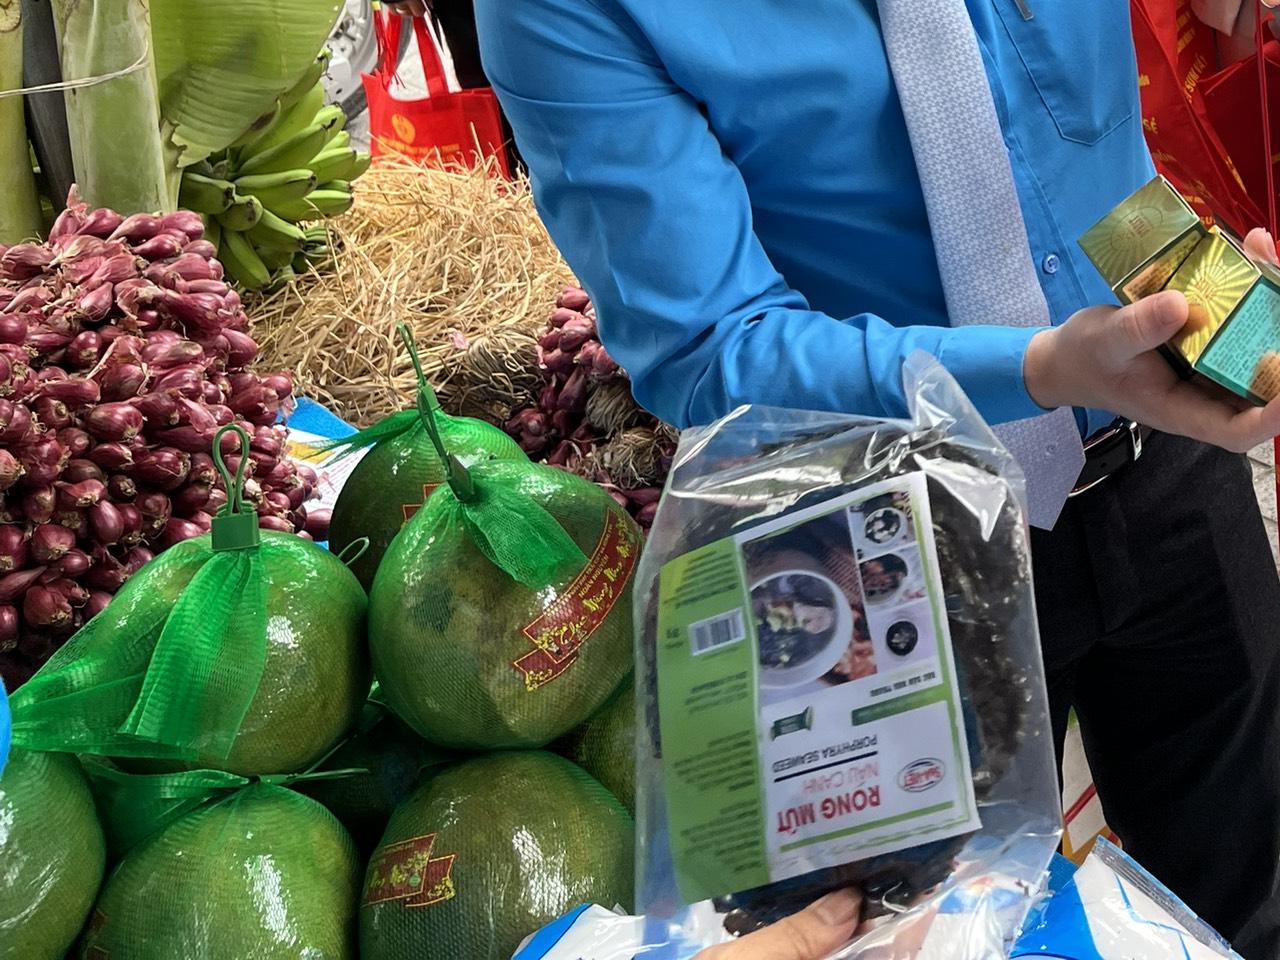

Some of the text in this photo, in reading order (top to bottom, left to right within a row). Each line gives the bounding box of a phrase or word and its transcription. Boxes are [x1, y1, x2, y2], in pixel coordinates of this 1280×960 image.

[772, 734, 878, 774] PORPHYRA SEAWEED
[802, 769, 846, 794] CANH
[777, 784, 881, 836] RONG MỨT
